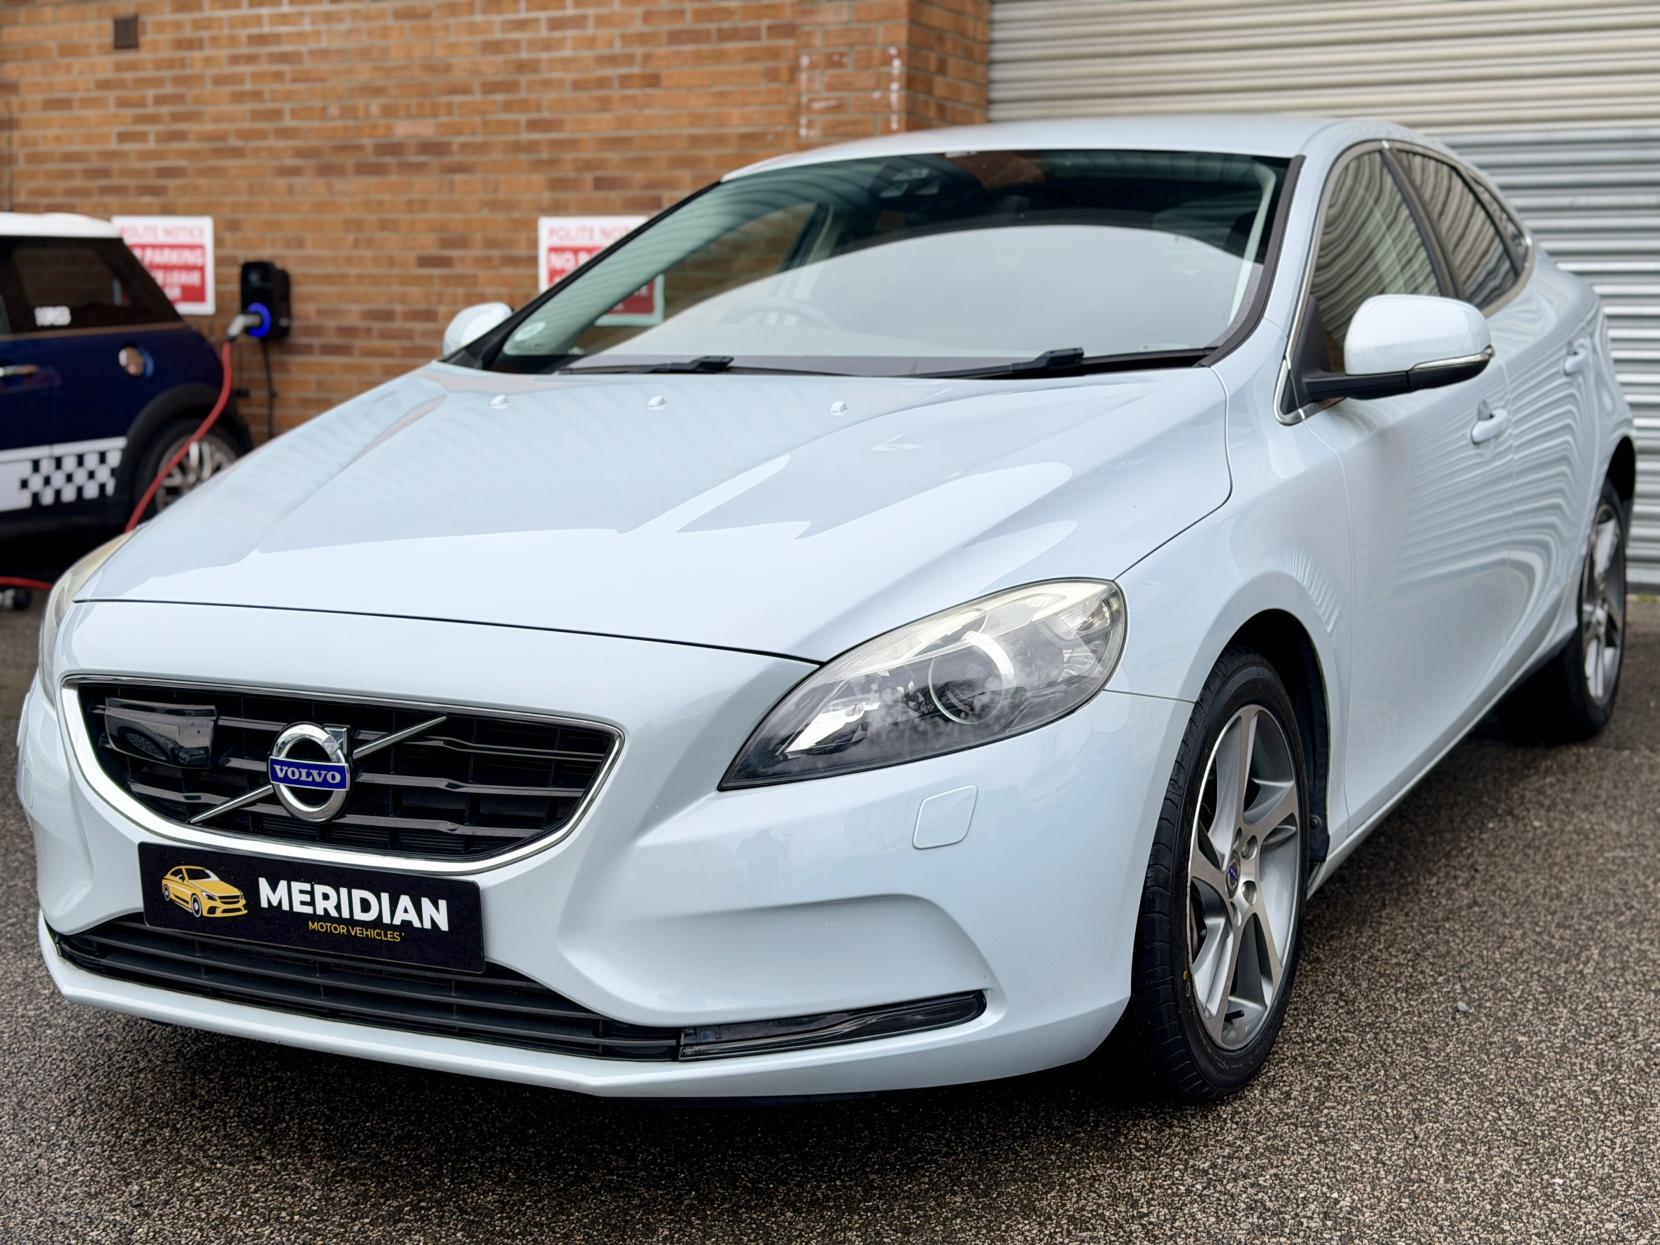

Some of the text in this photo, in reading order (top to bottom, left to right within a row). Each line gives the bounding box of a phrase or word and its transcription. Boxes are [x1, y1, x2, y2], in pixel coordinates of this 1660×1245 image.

[163, 225, 205, 239] NOTICE
[549, 225, 595, 241] POLITE
[143, 247, 205, 265] PARKING
[549, 250, 576, 270] NO
[273, 764, 341, 784] VOLVO
[258, 877, 450, 932] MERIDIAN
[308, 920, 401, 942] MOTOR VEHICLES
